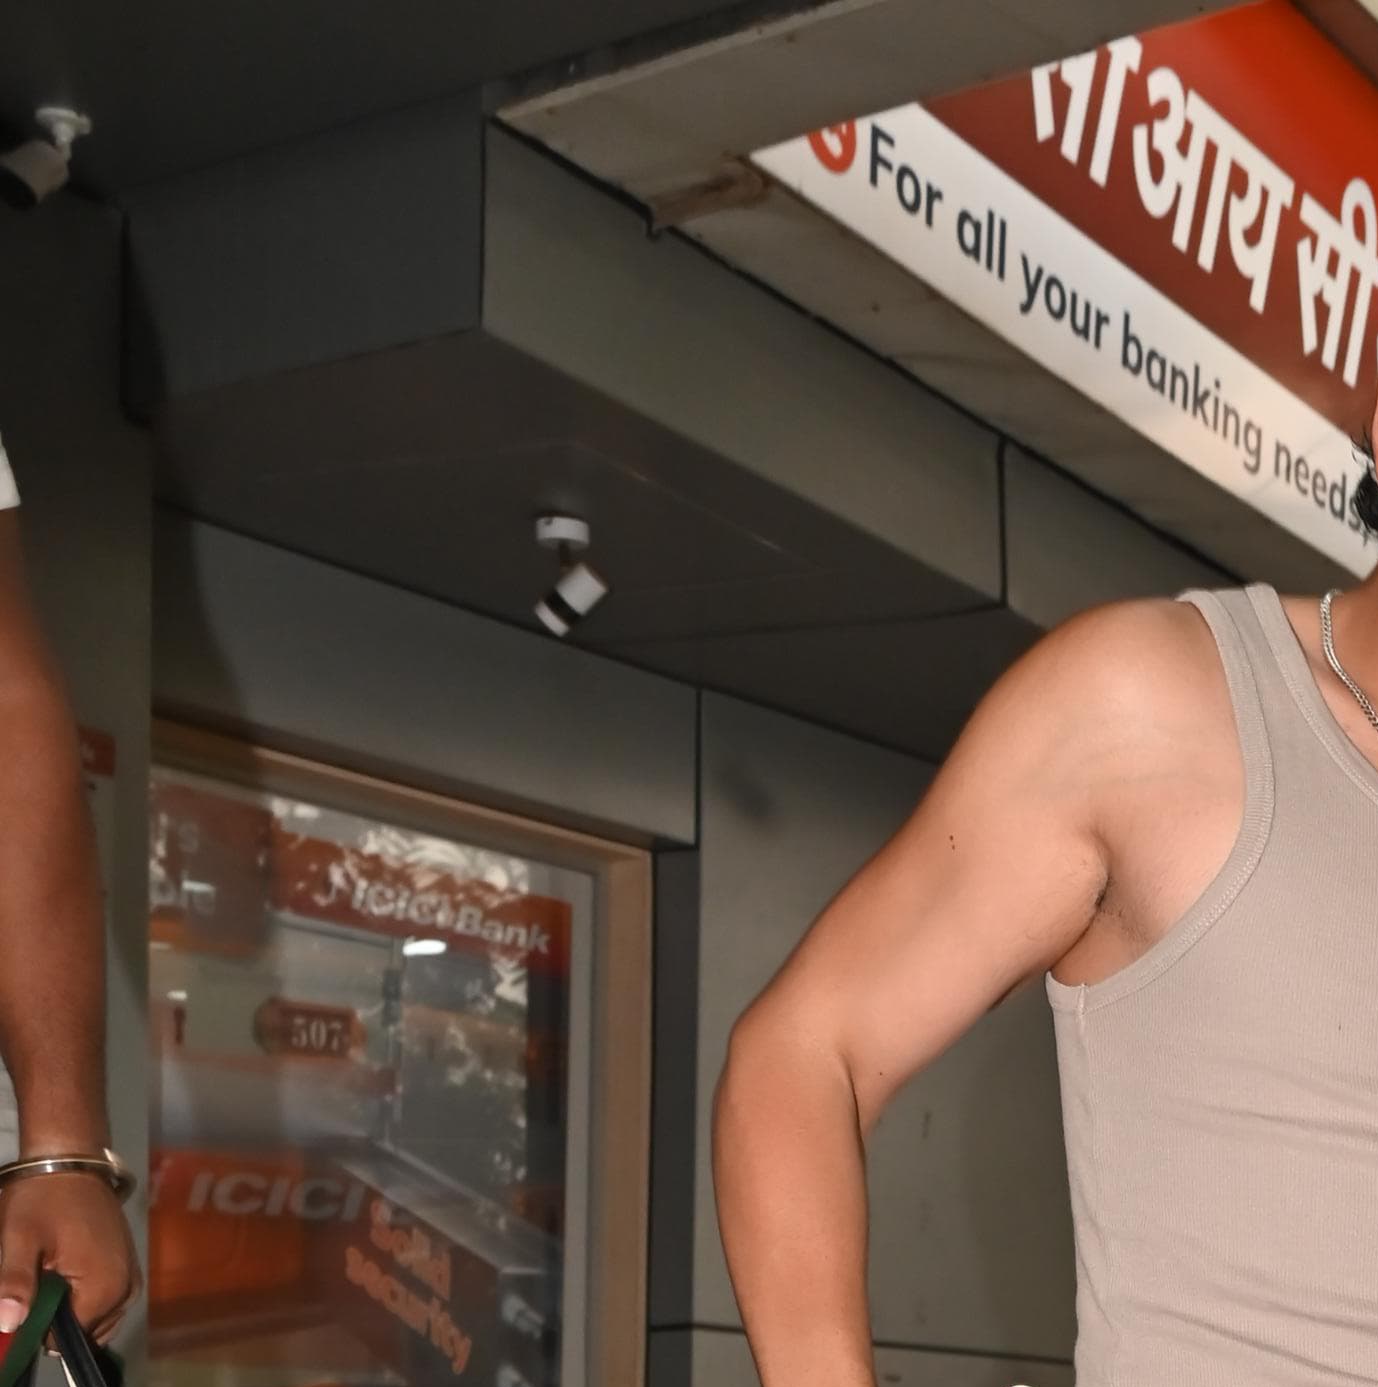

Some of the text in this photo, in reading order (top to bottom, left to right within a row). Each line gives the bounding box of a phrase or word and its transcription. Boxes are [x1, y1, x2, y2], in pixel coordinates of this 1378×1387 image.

[1132, 66, 1295, 314] आय
[870, 122, 943, 229] For
[956, 207, 1007, 281] all
[1019, 251, 1109, 350] your
[1121, 311, 1263, 475] banking
[456, 904, 550, 954] Bank
[186, 1170, 367, 1223] ICICI
